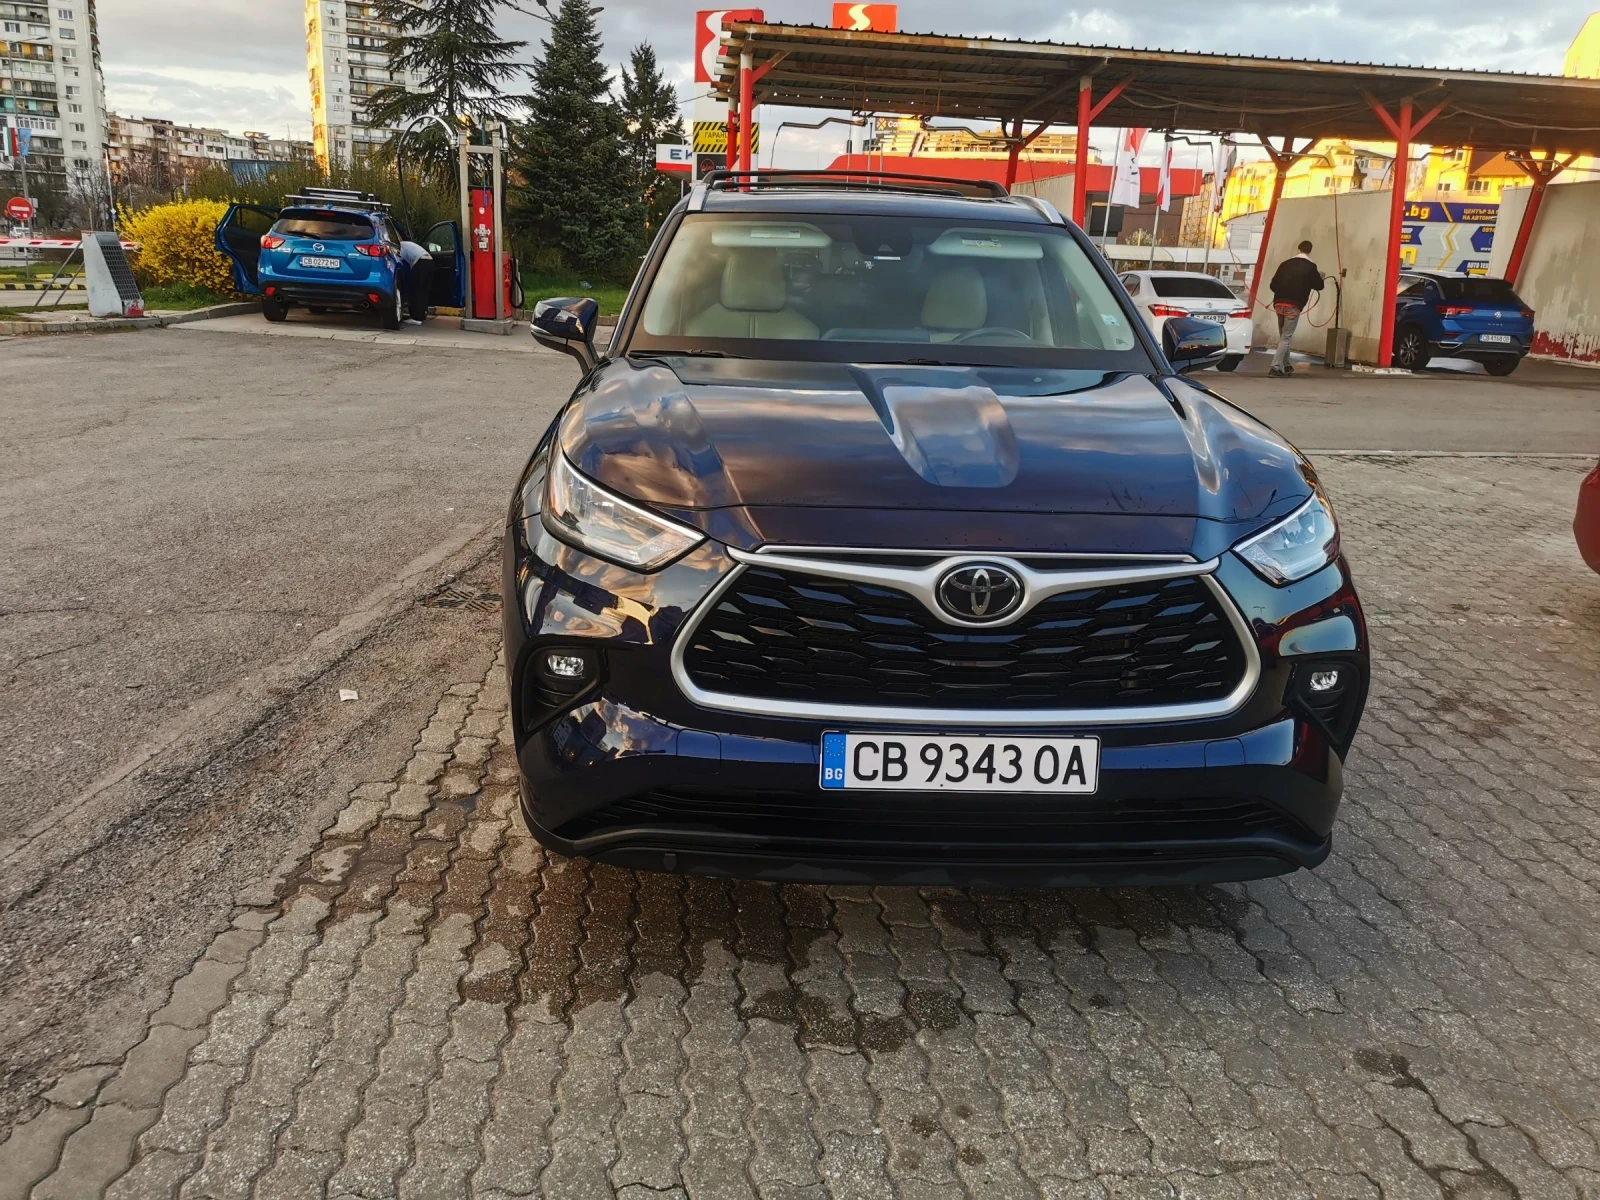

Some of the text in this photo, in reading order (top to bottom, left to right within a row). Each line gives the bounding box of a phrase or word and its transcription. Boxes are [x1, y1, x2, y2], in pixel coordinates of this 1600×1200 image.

[314, 258, 329, 266] 0272
[853, 741, 1087, 785] CB 9343 OA
[825, 767, 843, 780] BG
